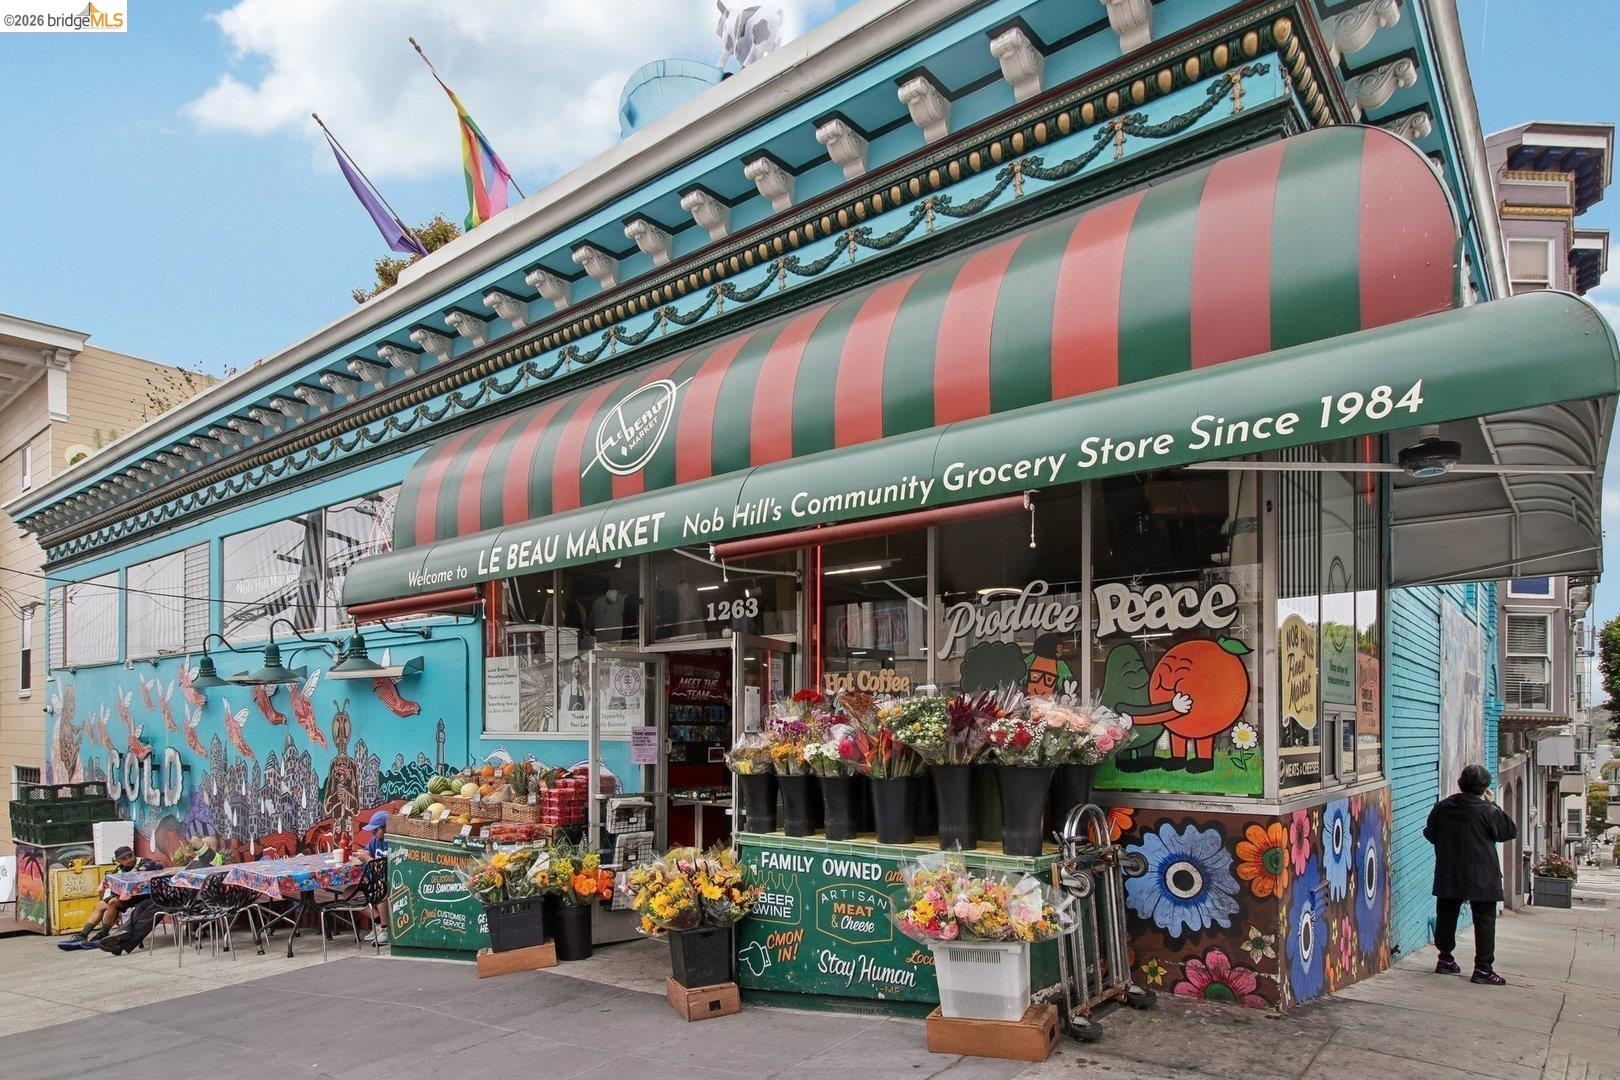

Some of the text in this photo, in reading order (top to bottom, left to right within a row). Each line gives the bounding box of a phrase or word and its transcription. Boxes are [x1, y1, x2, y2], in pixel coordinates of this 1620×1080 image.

[628, 416, 659, 451] MARKET
[408, 378, 1424, 587] Welcome to LE BEAU MARKET Nob Hill's Community Grocery Store Since 1984
[707, 598, 759, 622] 1263
[937, 579, 1080, 660] Produce
[1093, 582, 1239, 638] Peace
[1286, 624, 1299, 650] NOB
[678, 677, 702, 690] MEET
[824, 668, 911, 694] Hot Coffee
[686, 689, 711, 701] TEAM
[107, 747, 183, 807] COLD
[1285, 760, 1300, 777] MEATS
[1302, 758, 1320, 775] CHEESES
[408, 849, 469, 868] NOB HILL COMMUNI
[761, 851, 815, 874] FAMILY
[822, 858, 882, 881] OWNED
[423, 882, 468, 894] DELI SANDWICHE
[392, 895, 408, 914] MEALS
[759, 892, 795, 907] BEER
[821, 889, 888, 910] ARTISAN
[436, 909, 466, 922] CUSTOMER
[833, 902, 874, 917] MEAT
[397, 912, 409, 928] GO
[442, 918, 466, 930] SERVICE
[830, 914, 875, 934] & Cheese
[766, 928, 804, 950] C'MON
[777, 948, 799, 964] IN!
